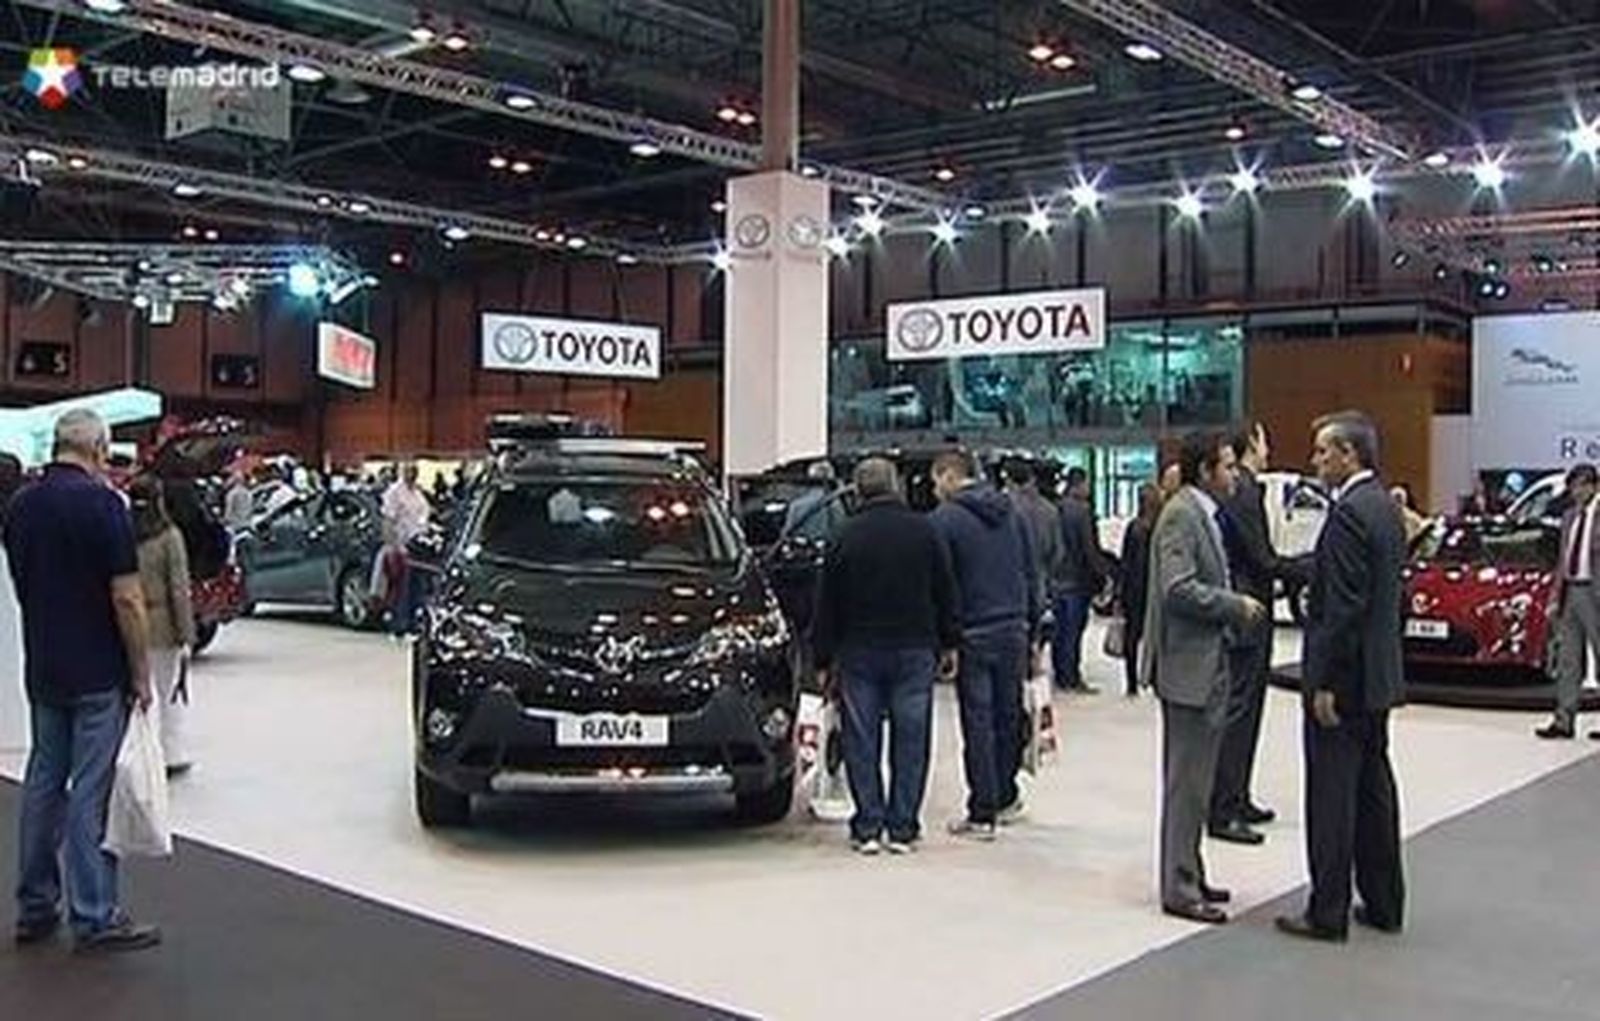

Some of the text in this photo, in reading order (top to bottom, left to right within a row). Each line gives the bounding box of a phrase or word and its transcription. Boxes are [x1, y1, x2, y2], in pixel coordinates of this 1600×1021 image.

[947, 303, 1091, 344] TOYOTA
[541, 329, 652, 367] TOYOTA
[581, 719, 643, 740] RAV4
